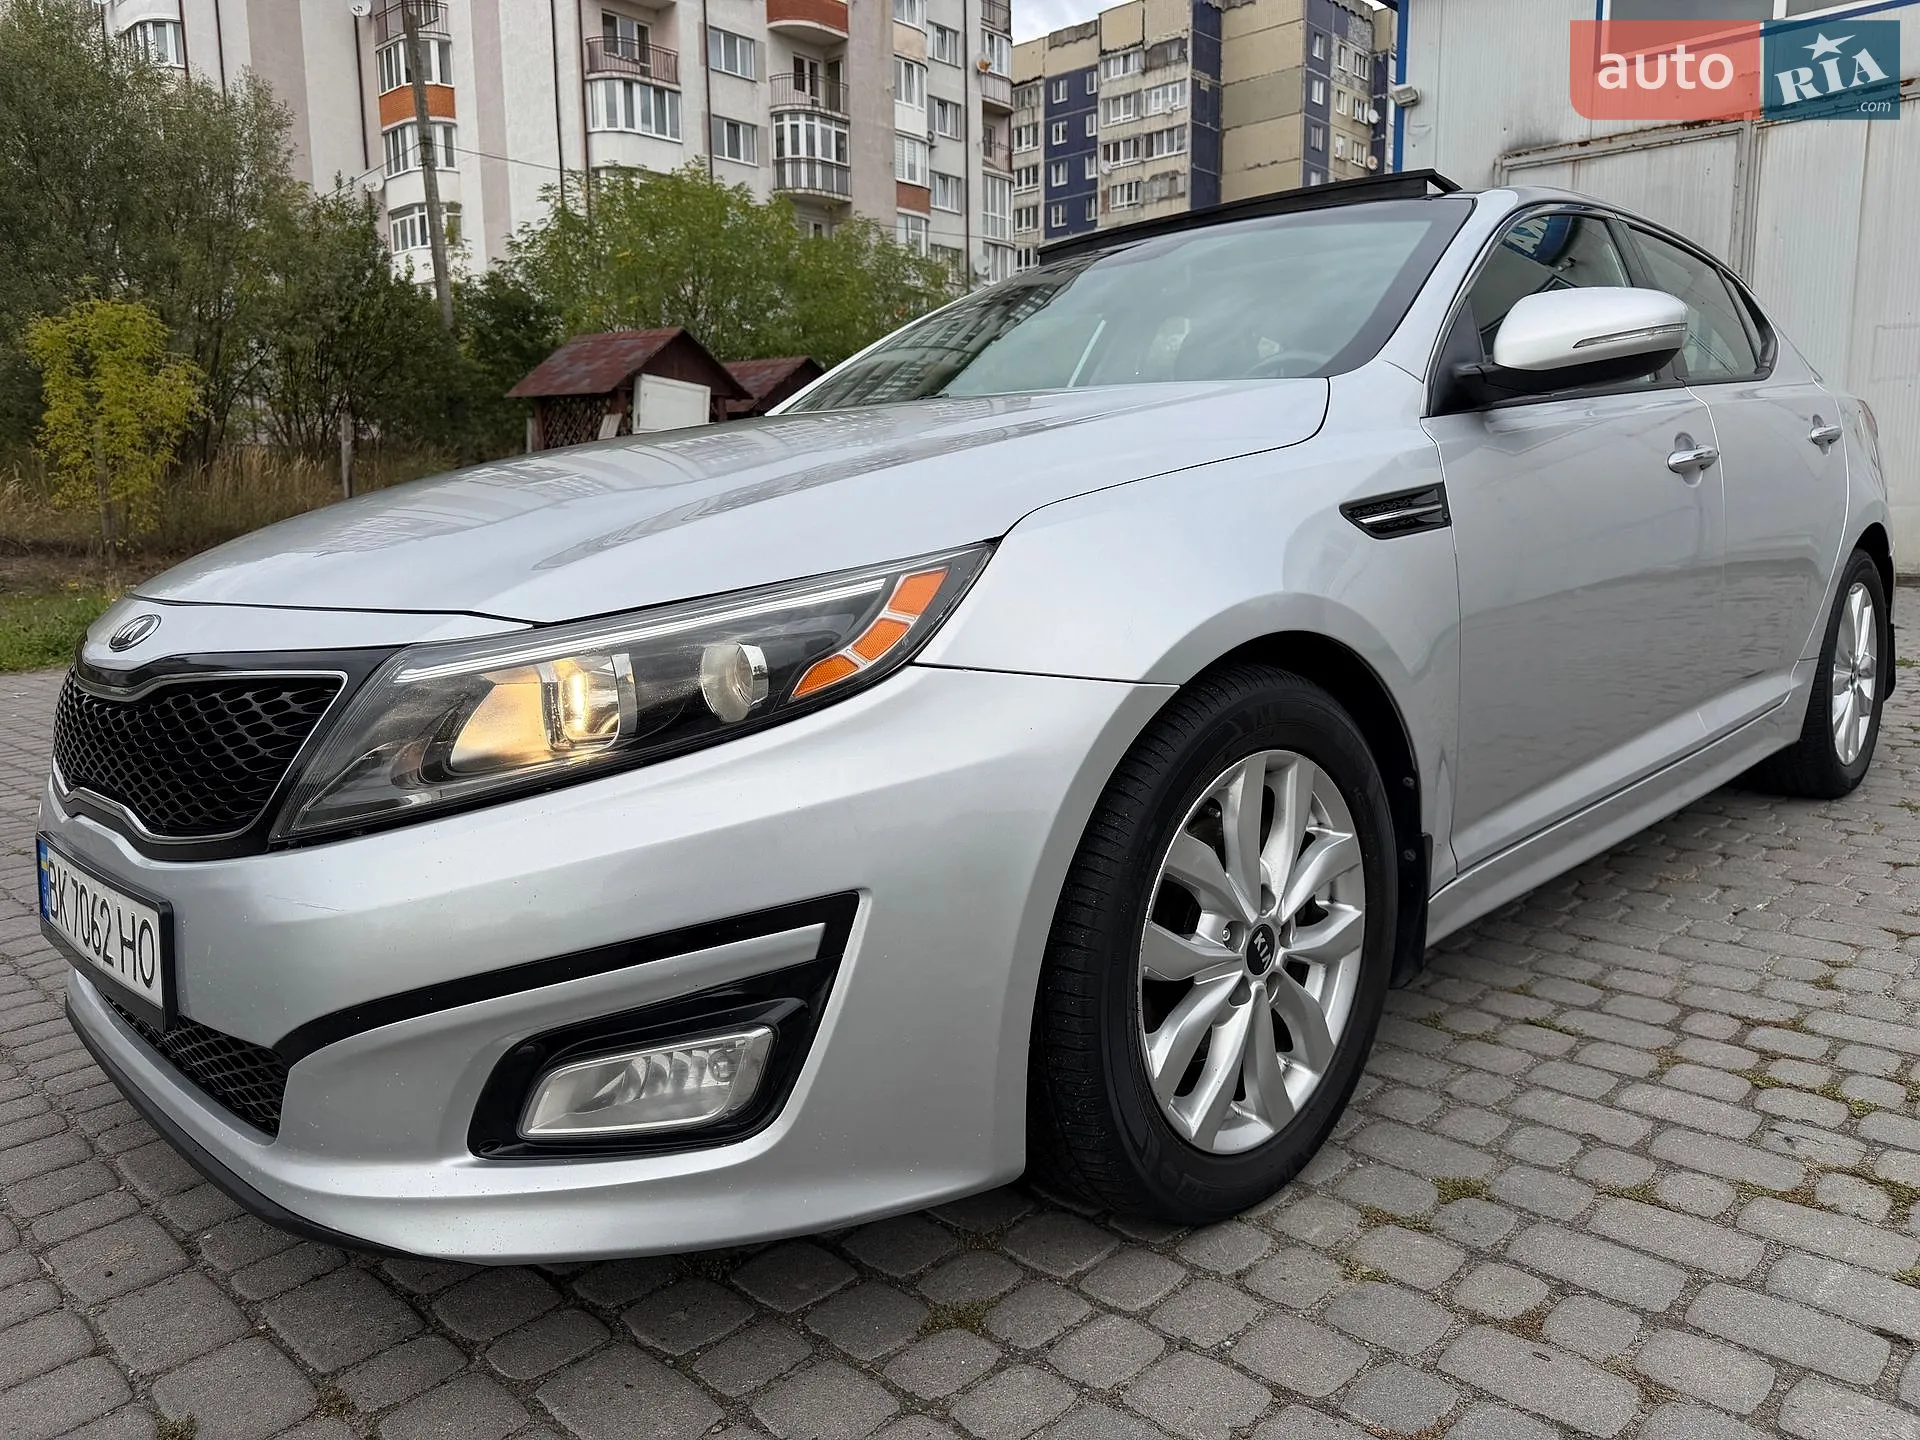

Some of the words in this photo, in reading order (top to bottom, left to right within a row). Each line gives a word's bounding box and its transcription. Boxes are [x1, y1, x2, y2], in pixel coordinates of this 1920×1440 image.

[48, 860, 70, 932] BK
[71, 876, 115, 968] 7062
[117, 905, 156, 990] HO
